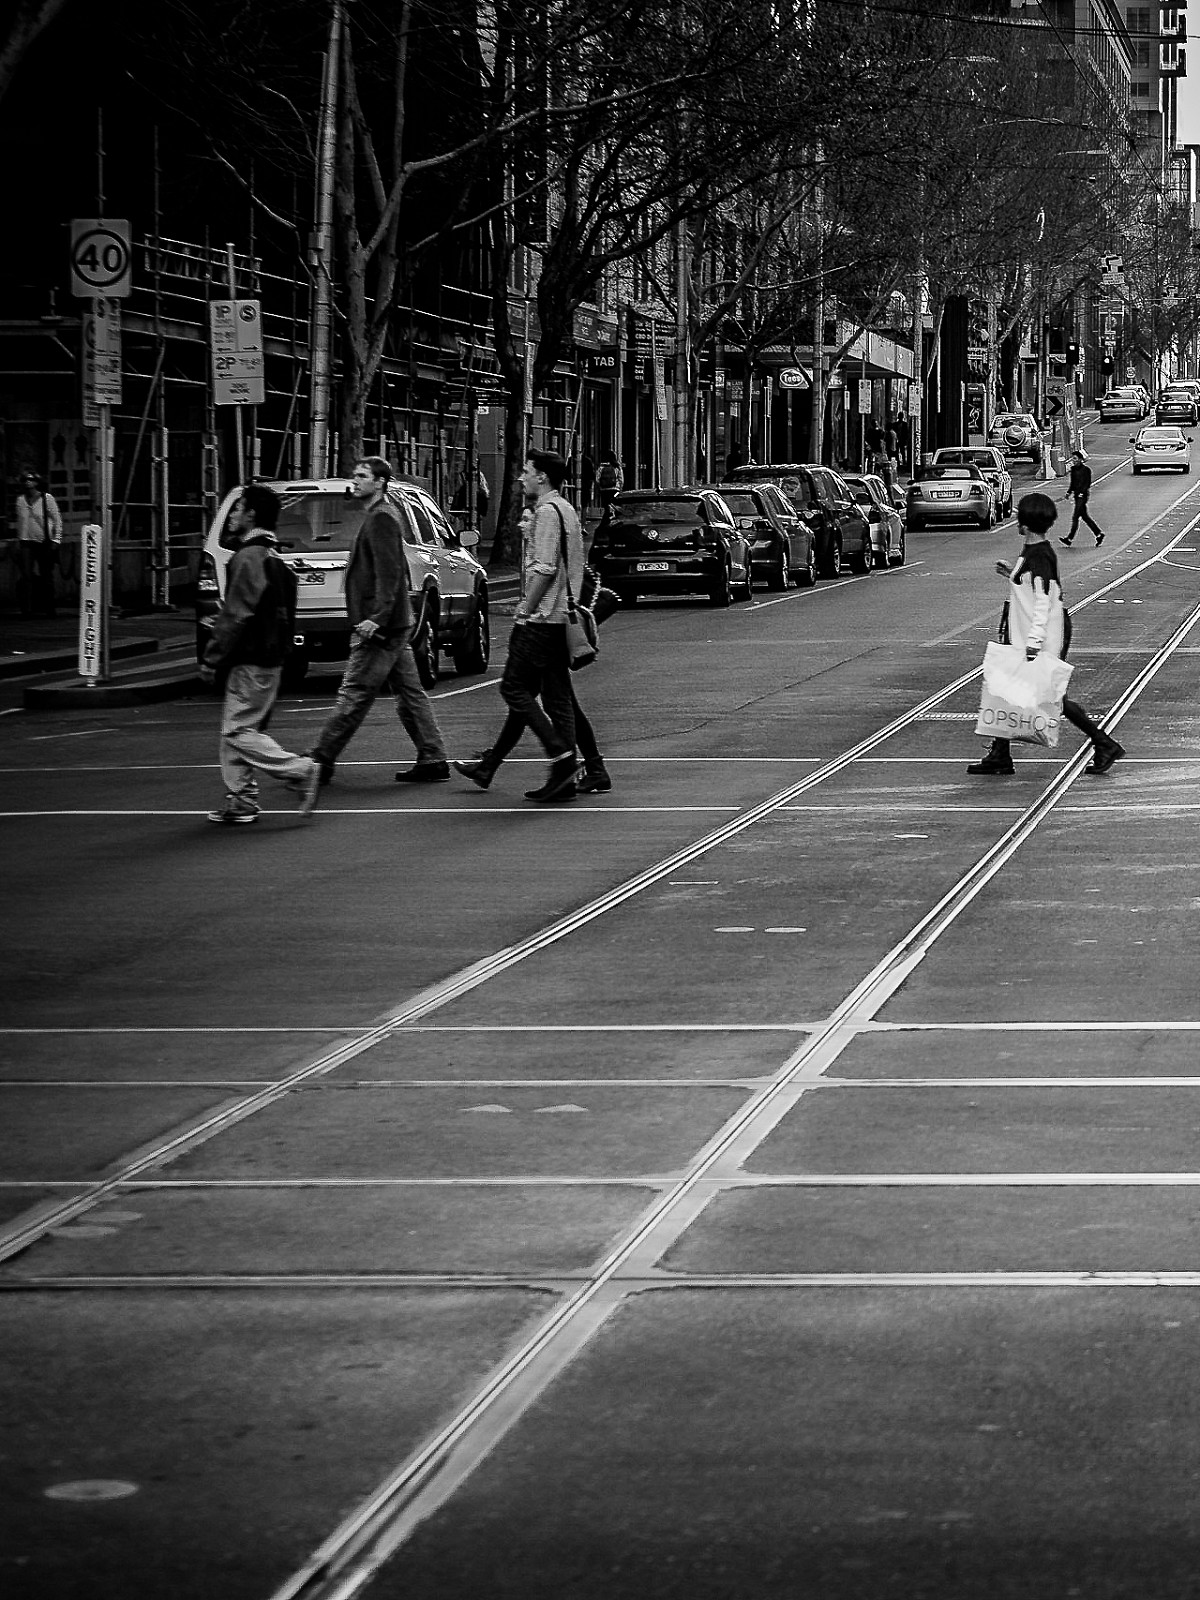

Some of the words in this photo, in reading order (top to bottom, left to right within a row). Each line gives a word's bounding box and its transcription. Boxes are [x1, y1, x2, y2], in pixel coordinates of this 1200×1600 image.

[77, 244, 121, 273] 40
[215, 305, 231, 318] 1P
[215, 356, 236, 370] 2P
[593, 356, 616, 367] TAB
[86, 529, 97, 587] KEEP
[85, 599, 97, 673] RIGHT
